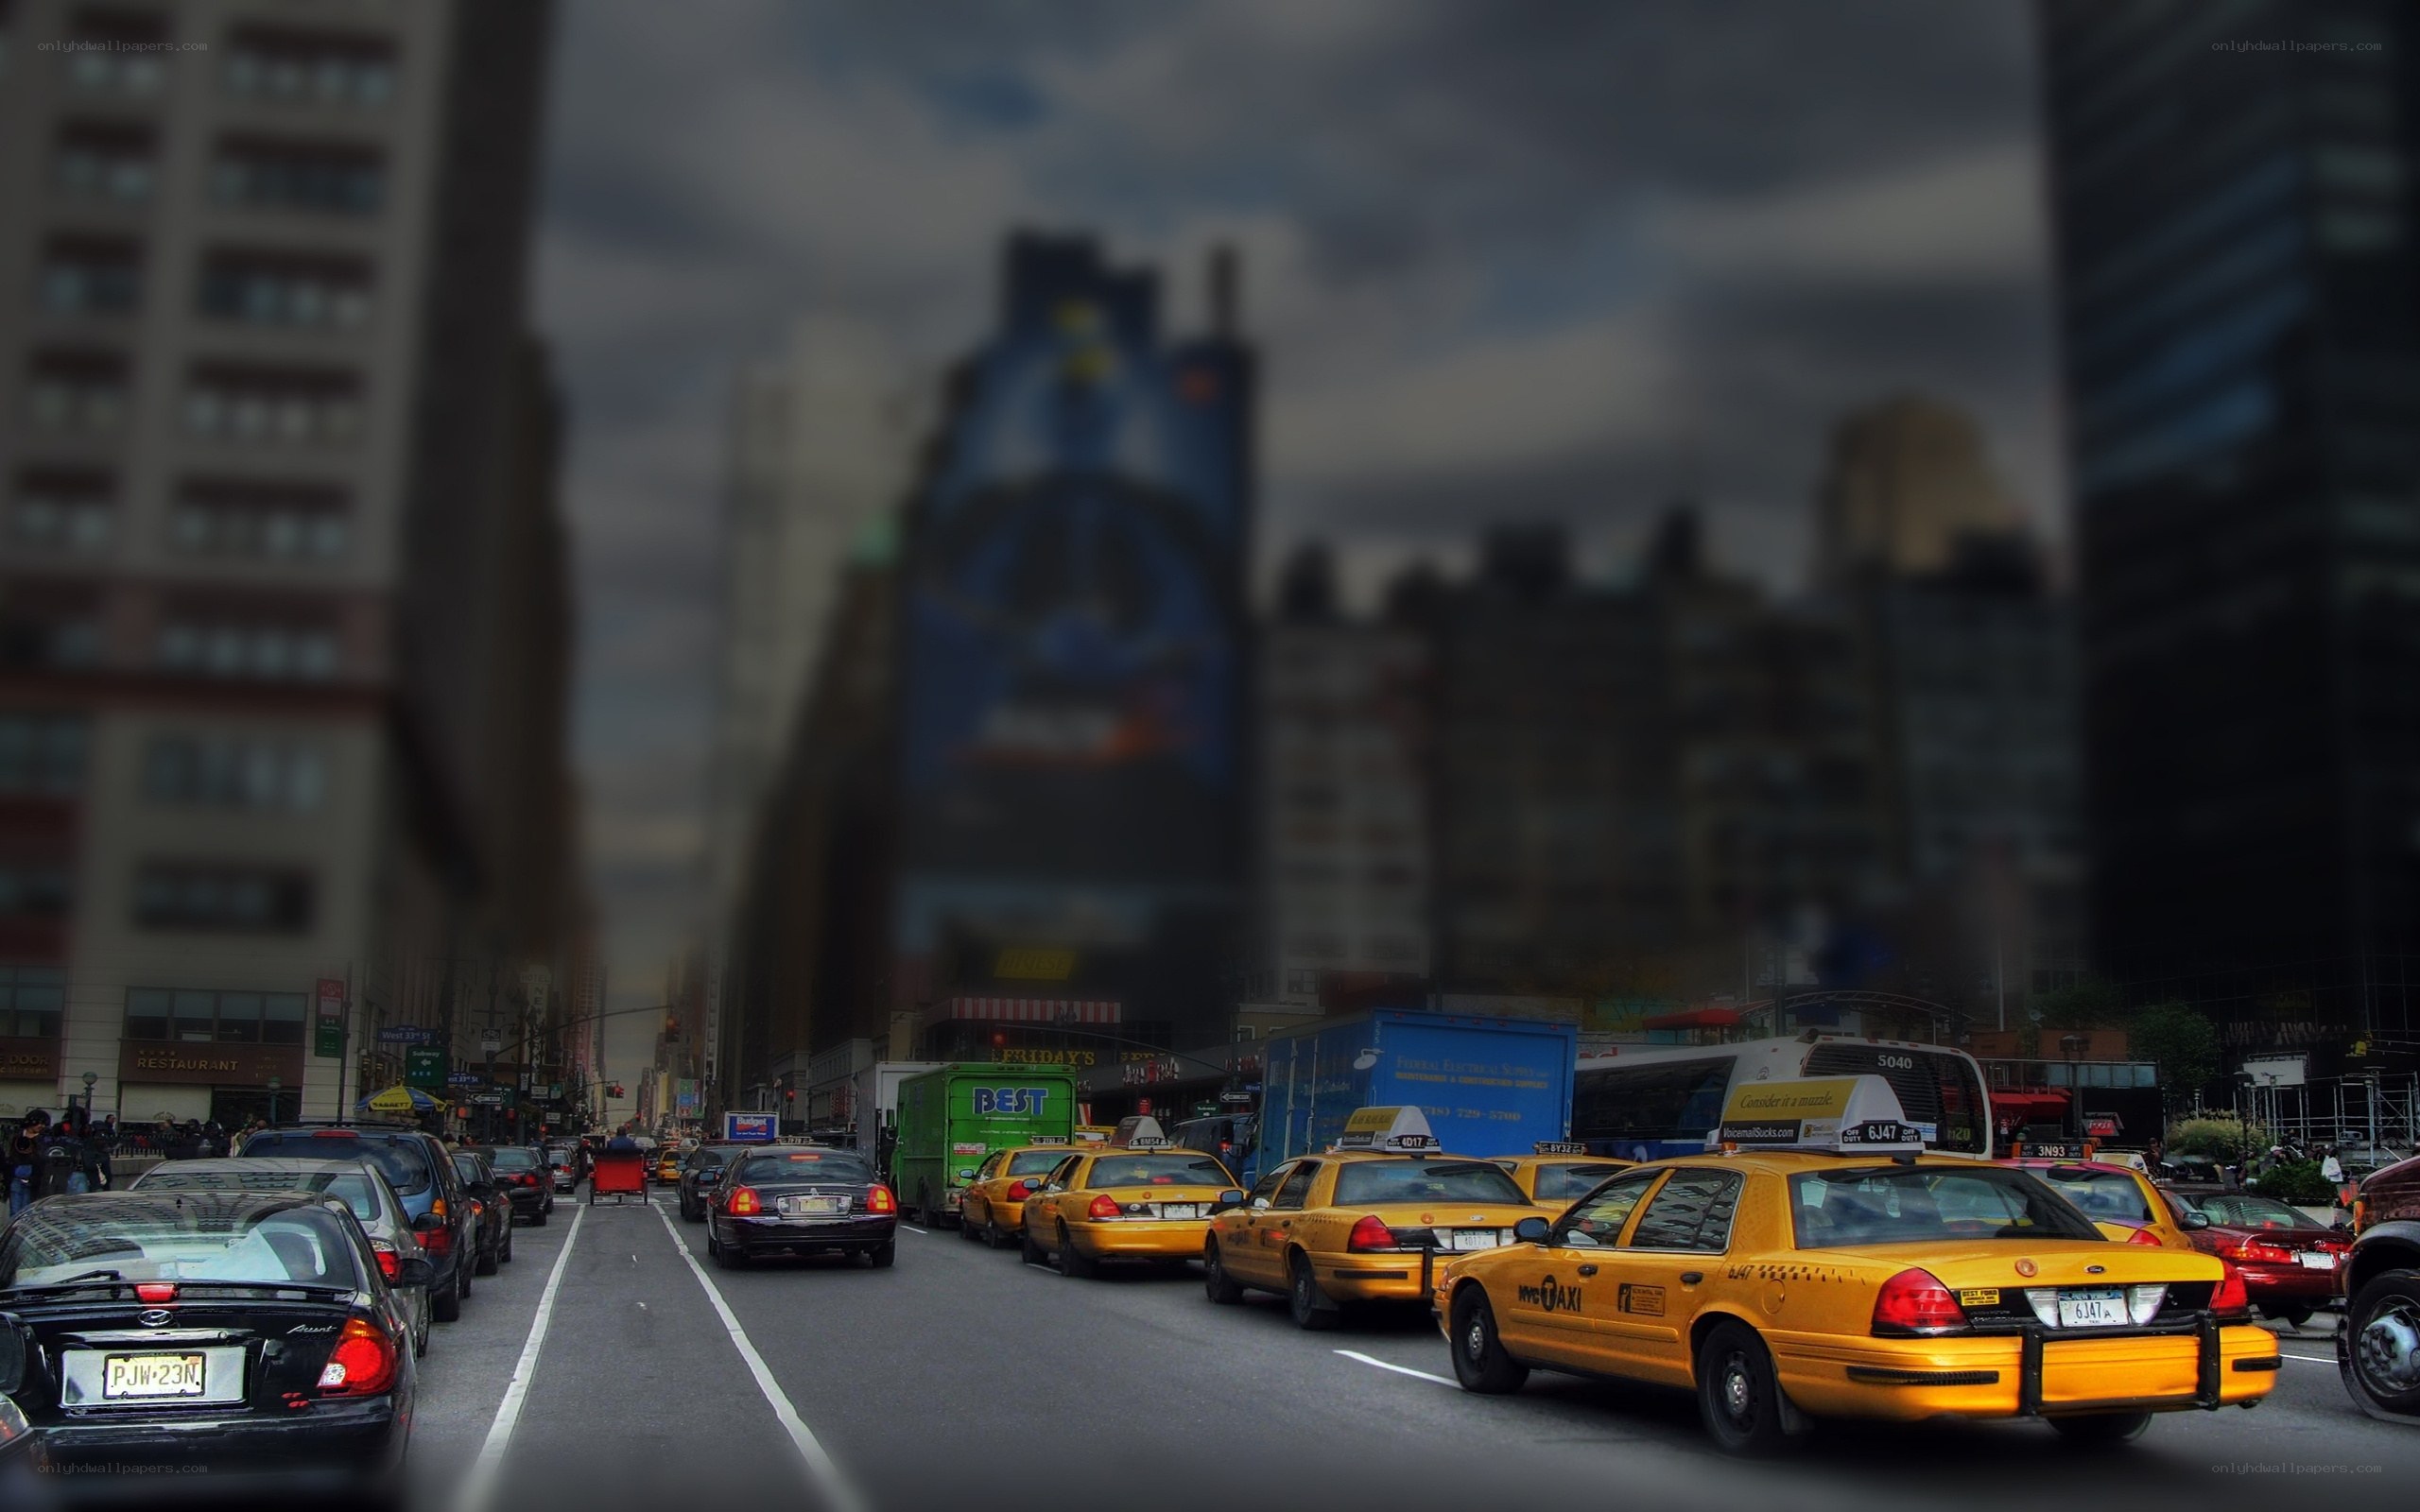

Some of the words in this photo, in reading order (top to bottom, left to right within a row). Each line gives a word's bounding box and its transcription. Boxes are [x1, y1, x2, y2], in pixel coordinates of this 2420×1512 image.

[9, 1054, 48, 1066] DOOR
[412, 1050, 441, 1058] Subway
[1002, 1049, 1095, 1066] FRIDAY'S
[137, 1057, 239, 1072] RESTAURANT
[1877, 1055, 1912, 1070] 5040
[973, 1088, 1048, 1115] BEST
[1740, 1093, 1781, 1108] Consider
[1782, 1093, 1789, 1108] it
[1791, 1098, 1797, 1107] a
[736, 1116, 767, 1126] Budget
[1722, 1126, 1794, 1140] VoicemailSucks.com
[1868, 1125, 1897, 1141] 6J47
[1401, 1137, 1423, 1147] 4D17
[1550, 1143, 1571, 1153] 8Y32
[2038, 1145, 2066, 1158] 3N93
[1518, 1285, 1542, 1305] NYC
[1542, 1278, 1582, 1313] TAXI
[2075, 1301, 2101, 1319] 6J47
[285, 1324, 337, 1334] Accent
